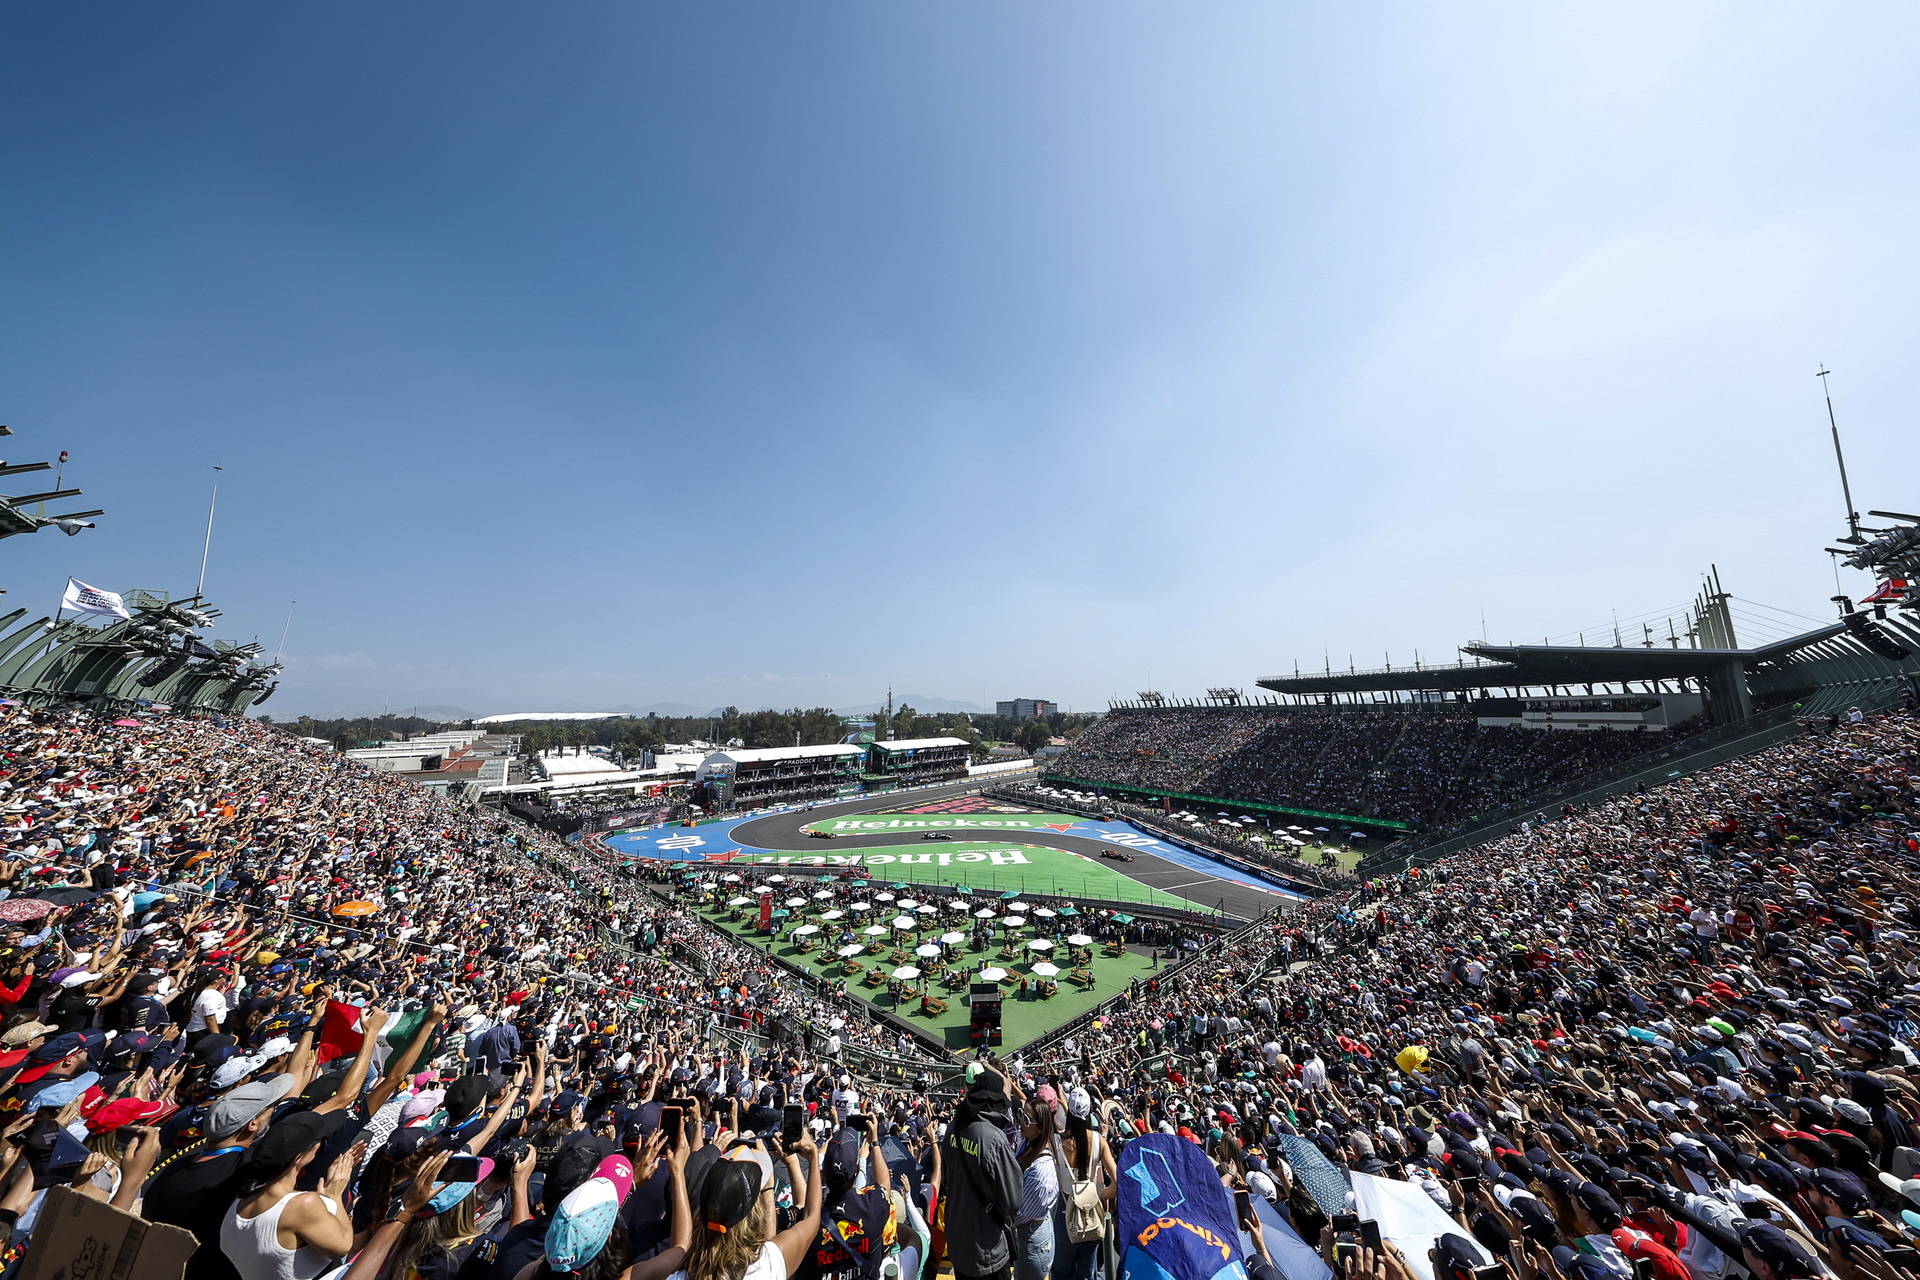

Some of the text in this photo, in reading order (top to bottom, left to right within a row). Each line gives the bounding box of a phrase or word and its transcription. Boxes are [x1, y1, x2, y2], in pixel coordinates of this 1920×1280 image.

[903, 797, 985, 814] MEXICO
[949, 802, 995, 813] CITY
[833, 819, 1033, 829] Heineken
[759, 850, 1033, 866] Heineken
[817, 1245, 843, 1267] Red
